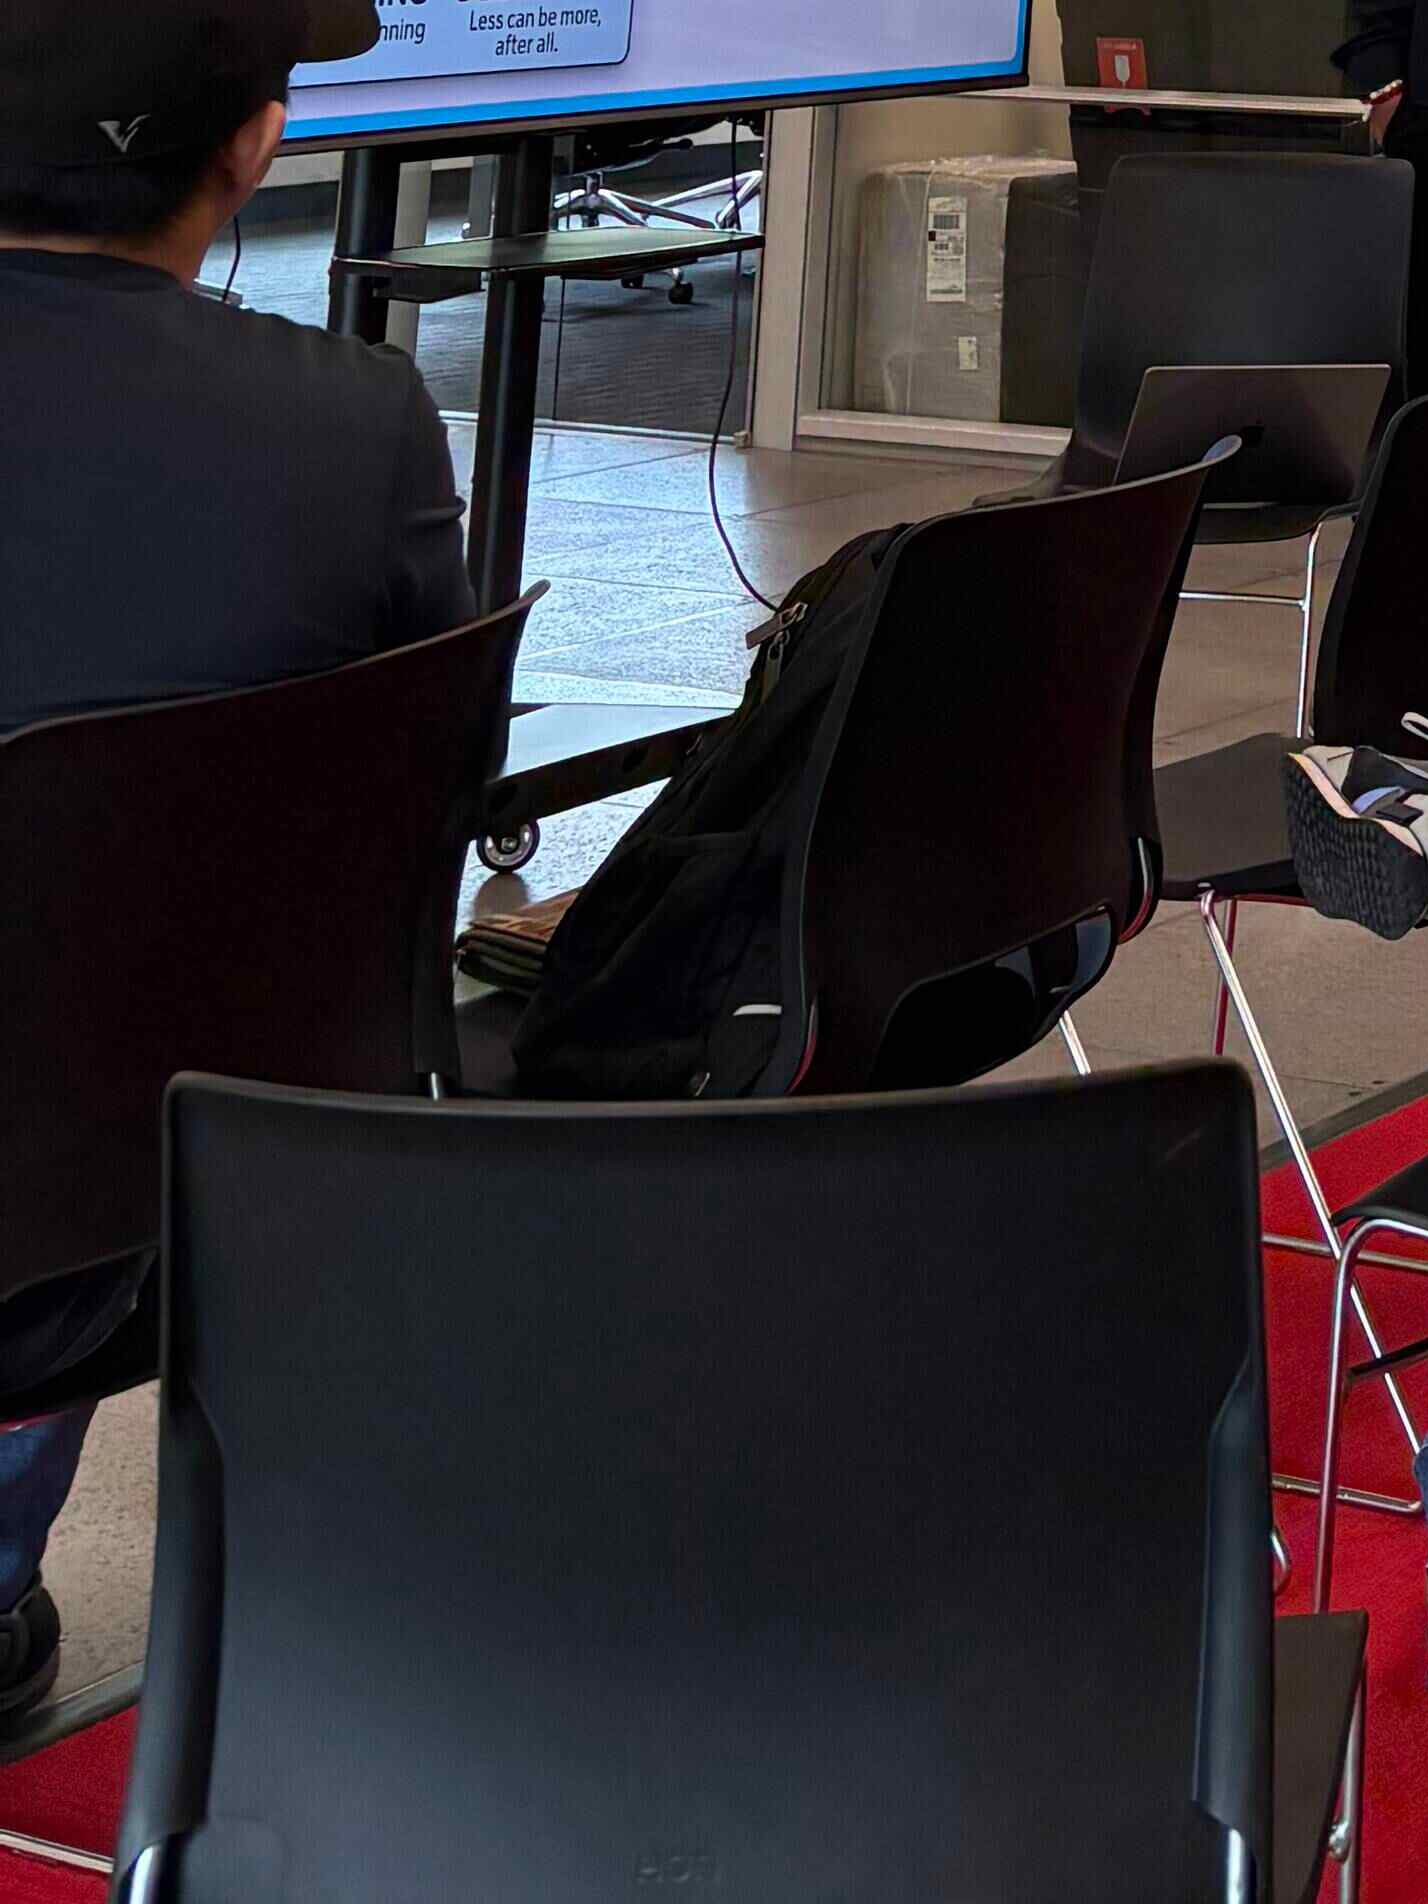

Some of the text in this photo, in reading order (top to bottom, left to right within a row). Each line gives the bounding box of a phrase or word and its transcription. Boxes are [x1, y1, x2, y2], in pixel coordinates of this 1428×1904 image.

[469, 5, 601, 31] Less can be more,
[379, 18, 426, 45] nning
[495, 31, 559, 56] after all.
